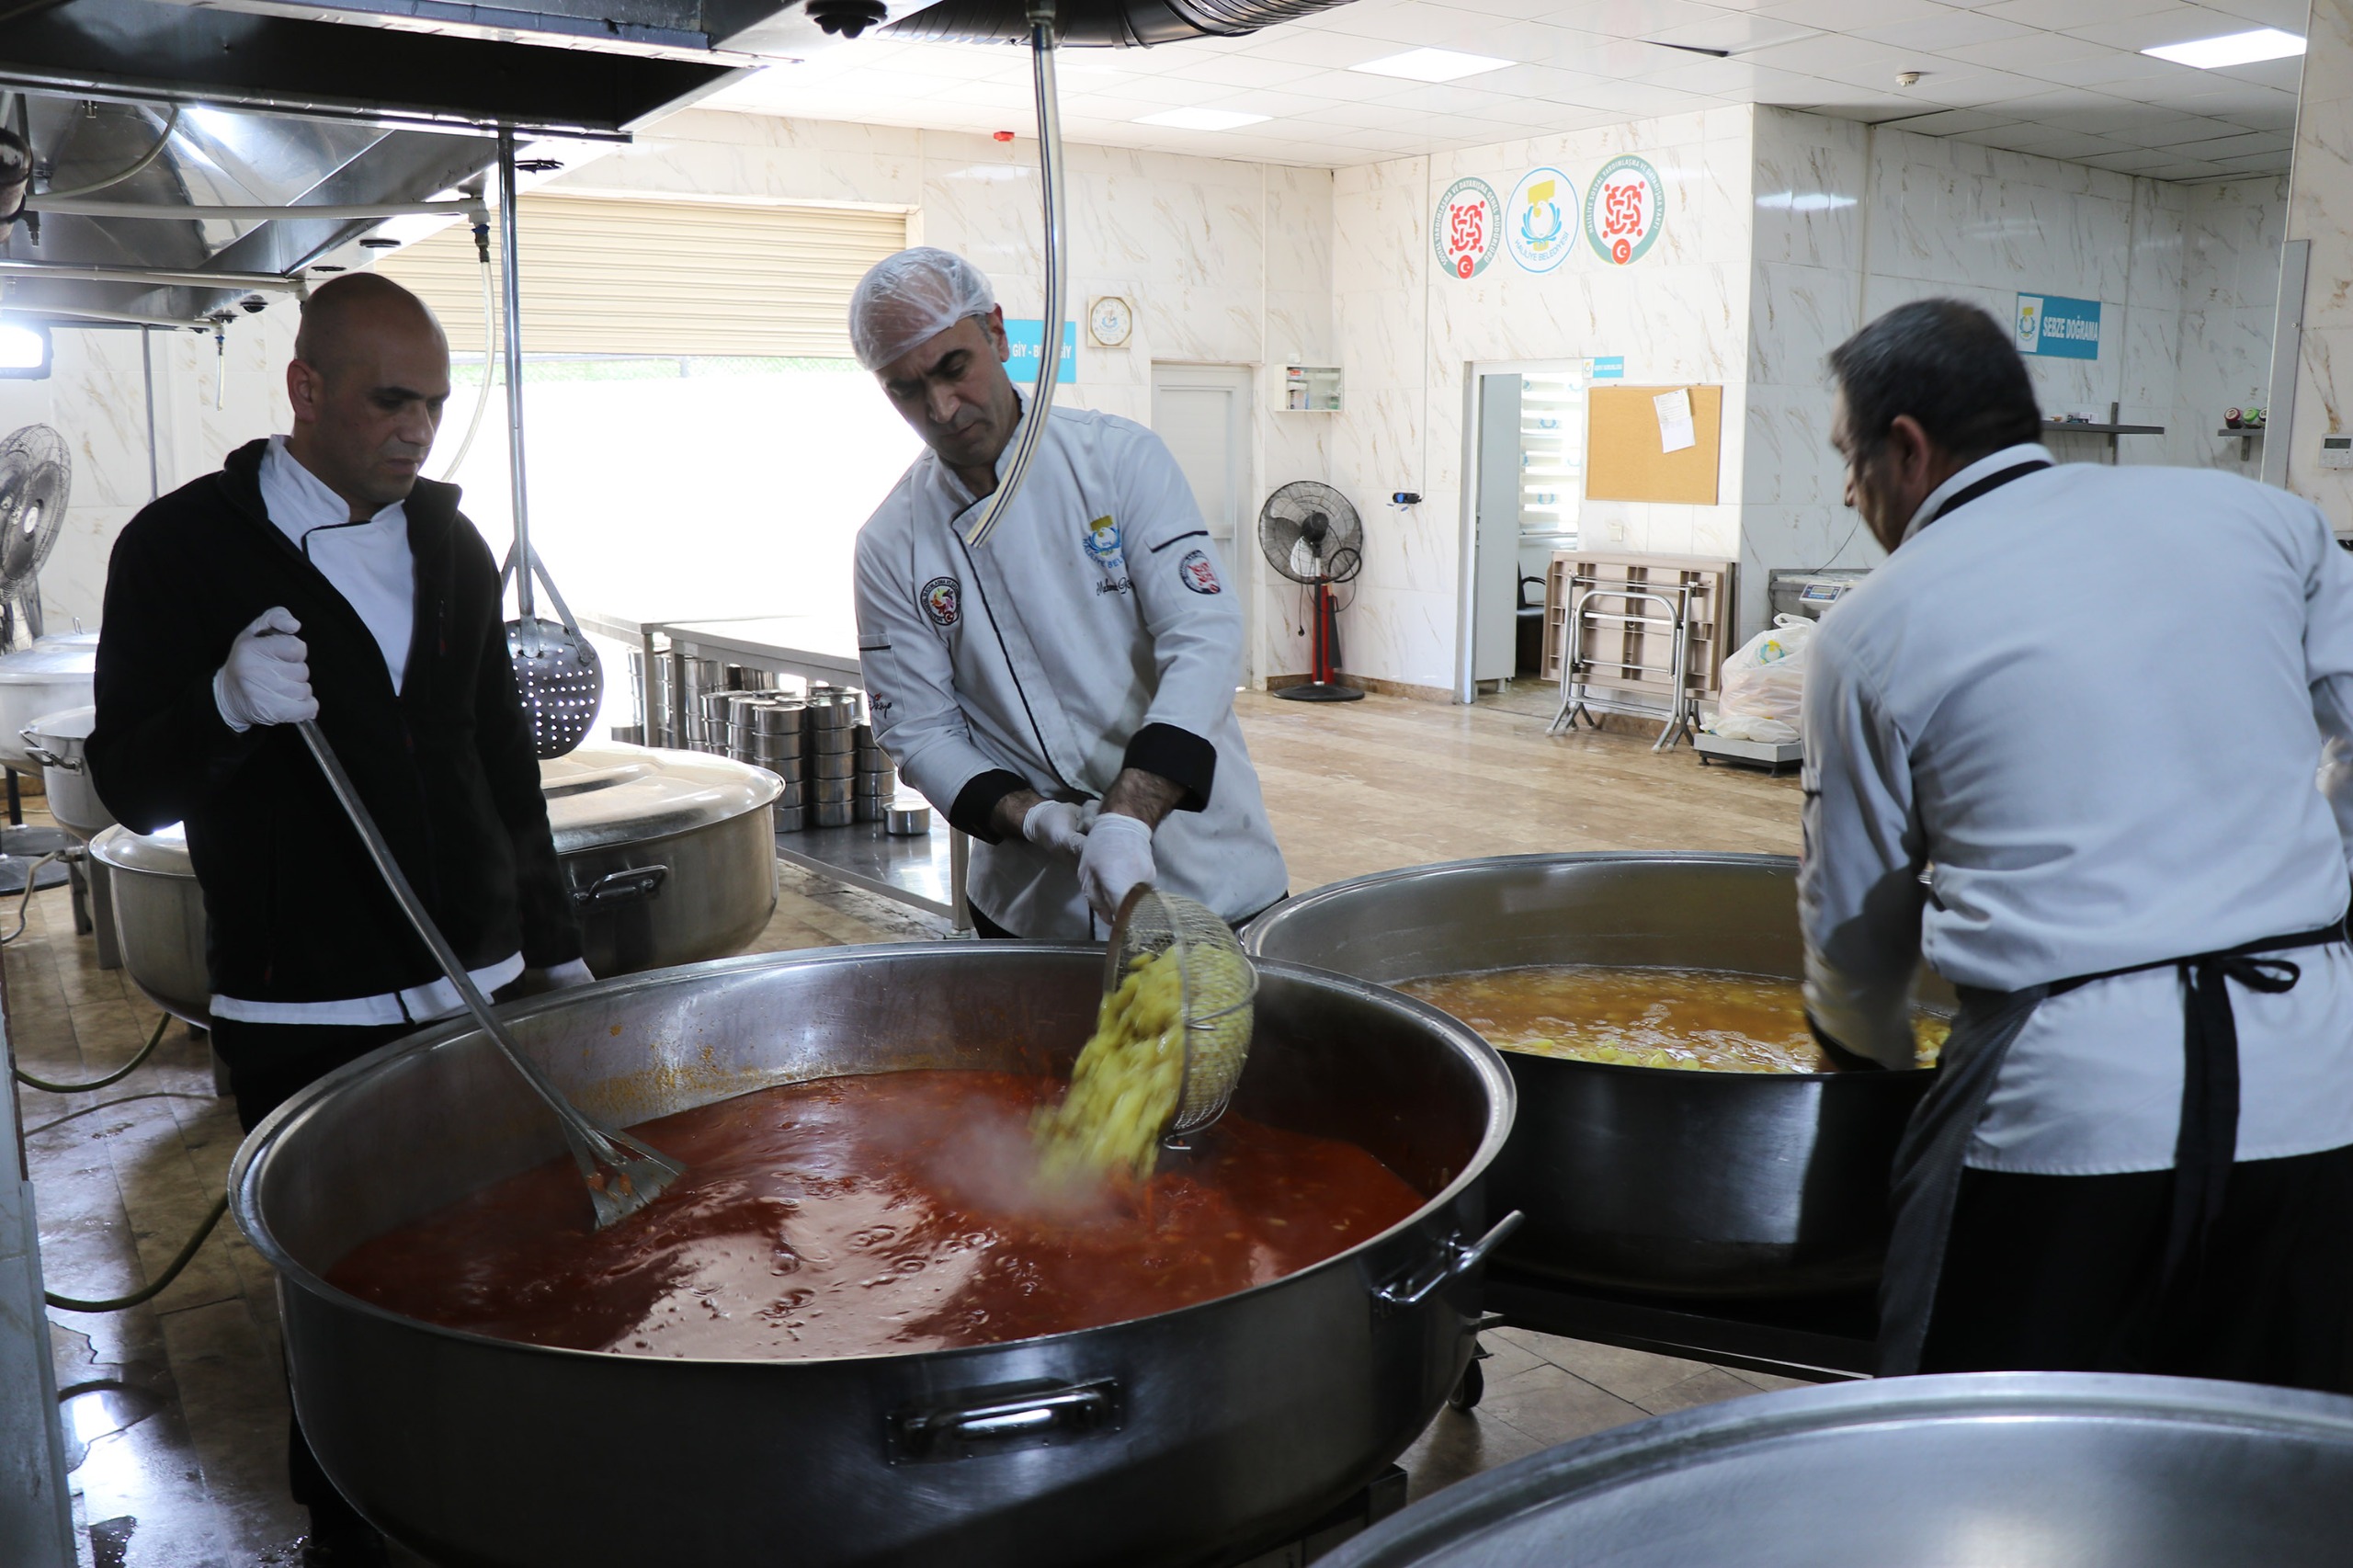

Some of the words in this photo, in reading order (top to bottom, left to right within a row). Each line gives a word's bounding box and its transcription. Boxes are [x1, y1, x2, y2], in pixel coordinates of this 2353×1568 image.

[1588, 176, 1604, 200] SOSYAL
[1640, 162, 1647, 172] VE
[1437, 241, 1448, 265] SOSYAL
[1486, 191, 1499, 214] GENEL
[2043, 317, 2065, 338] SEBZE
[2066, 315, 2098, 341] DOĞRAMA
[1013, 341, 1027, 357] GİY
